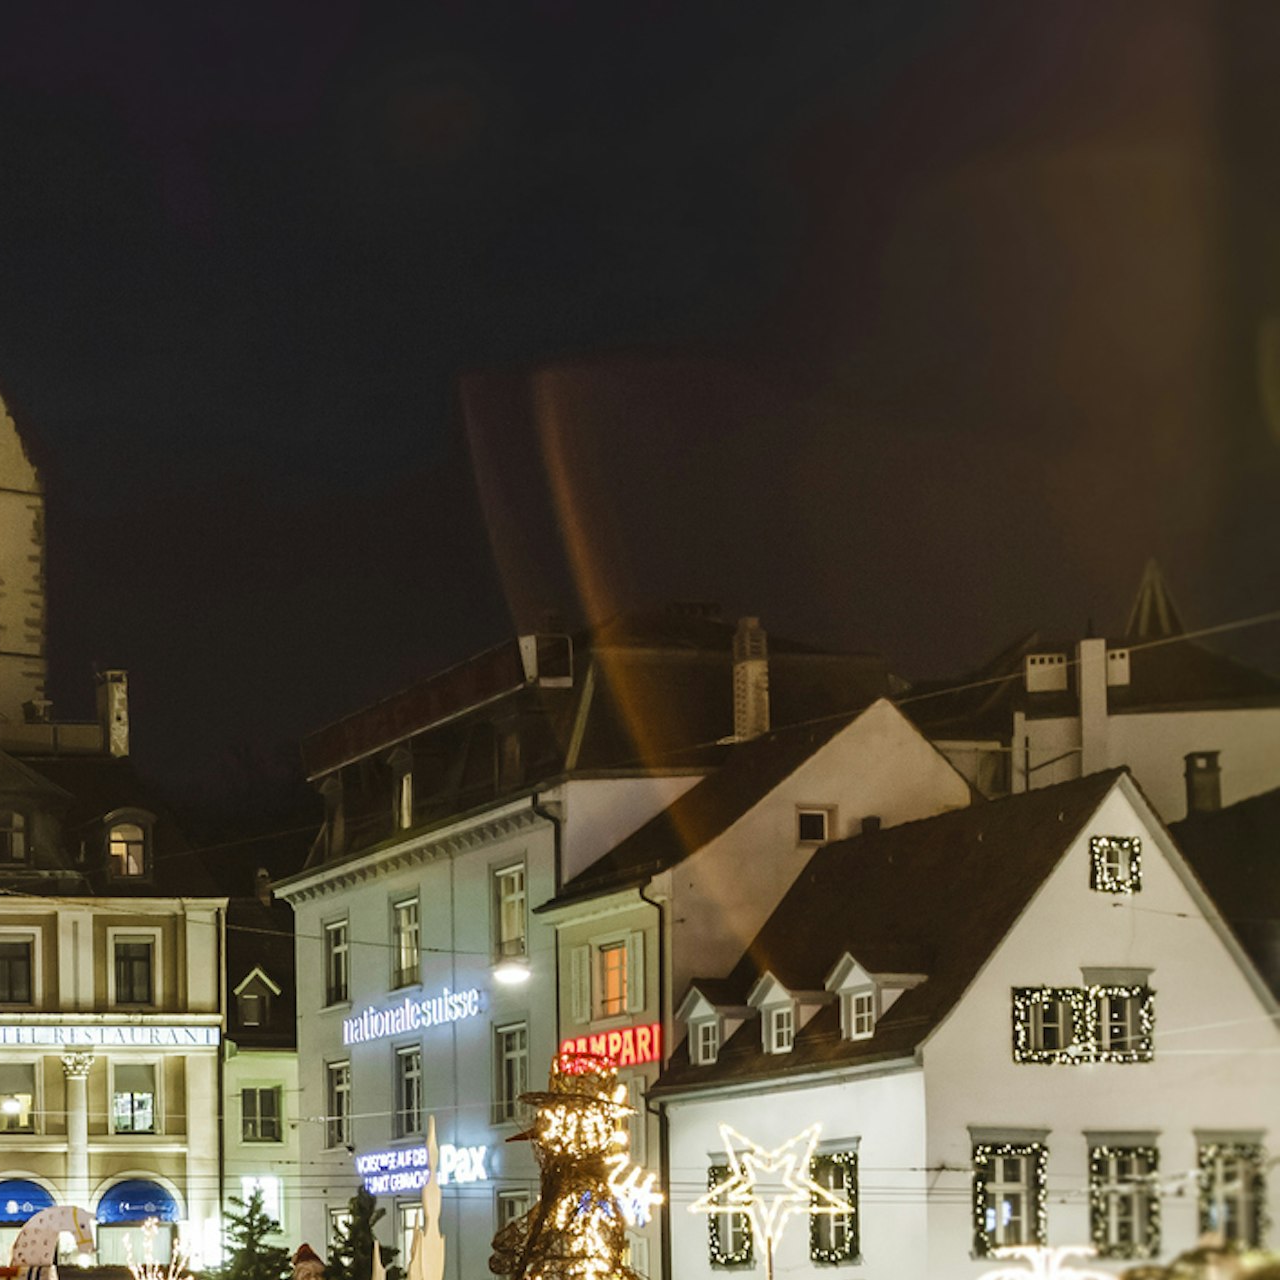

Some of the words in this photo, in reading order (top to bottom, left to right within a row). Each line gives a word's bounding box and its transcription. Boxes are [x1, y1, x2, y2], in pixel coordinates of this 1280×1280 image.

[53, 1027, 216, 1045] RESTAURANT
[343, 987, 480, 1045] nationalesuisse
[560, 1023, 661, 1073] CAMPARI
[438, 1144, 488, 1185] Pax
